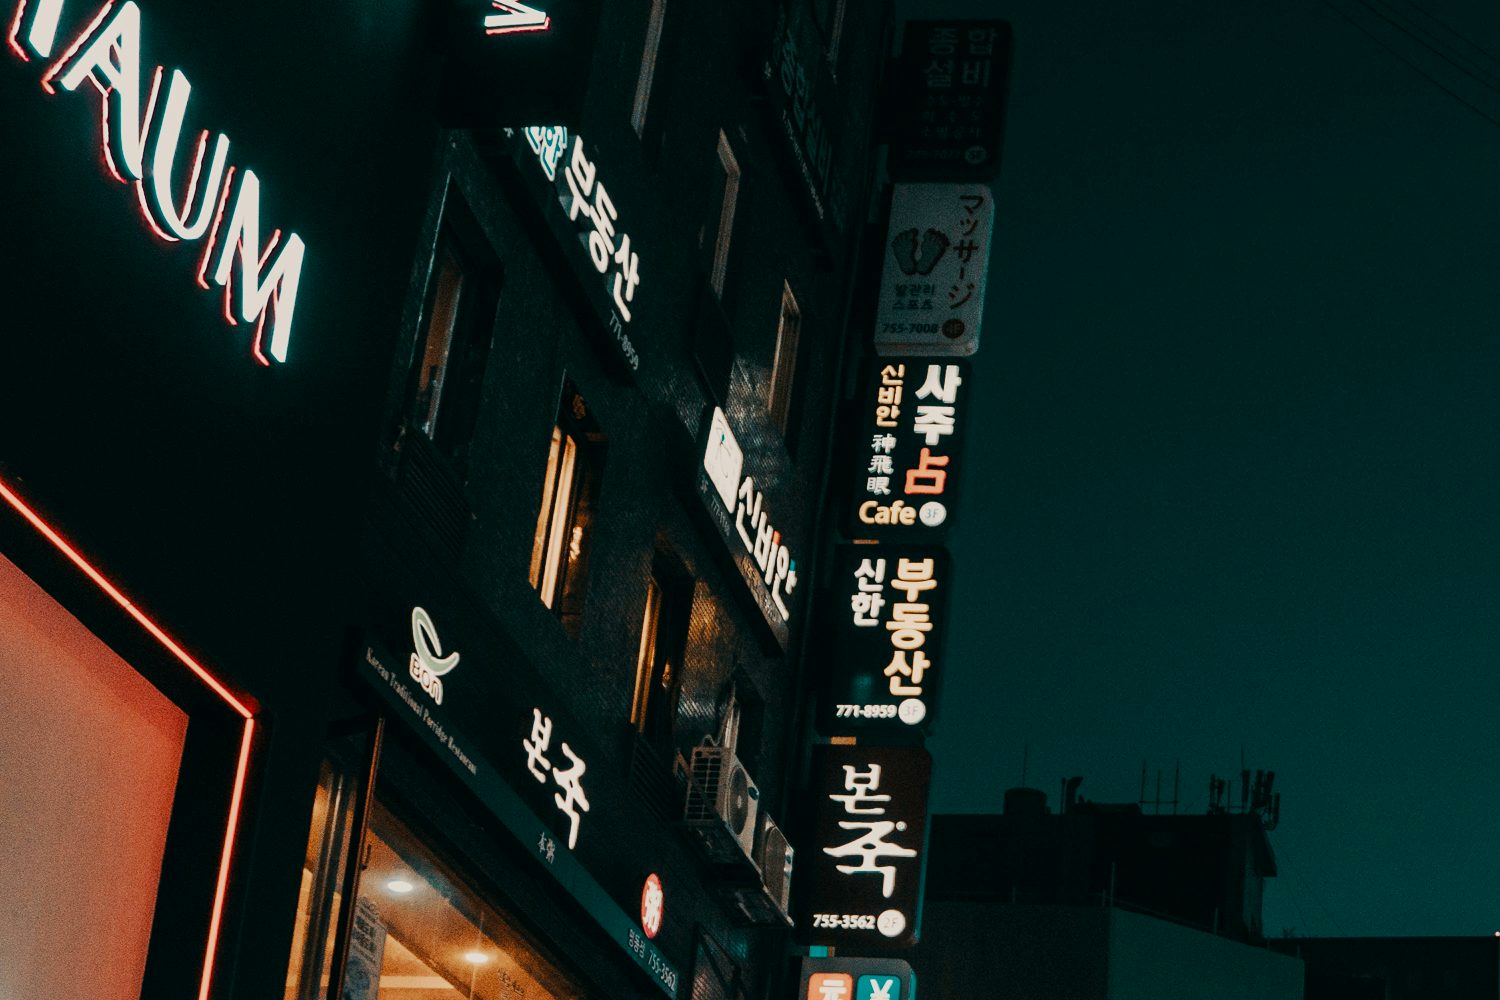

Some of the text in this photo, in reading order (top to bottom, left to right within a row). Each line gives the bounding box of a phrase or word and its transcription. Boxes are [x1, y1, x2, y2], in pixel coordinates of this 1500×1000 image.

[565, 134, 641, 323] 부동산
[949, 194, 984, 310] マッサージ
[876, 364, 906, 428] 신비안
[859, 500, 918, 526] Cafe
[852, 558, 886, 627] 신한
[884, 558, 938, 696] 부동산
[836, 704, 898, 719] 771-8959
[823, 763, 918, 898] 본죽
[813, 914, 876, 930] 755-3562
